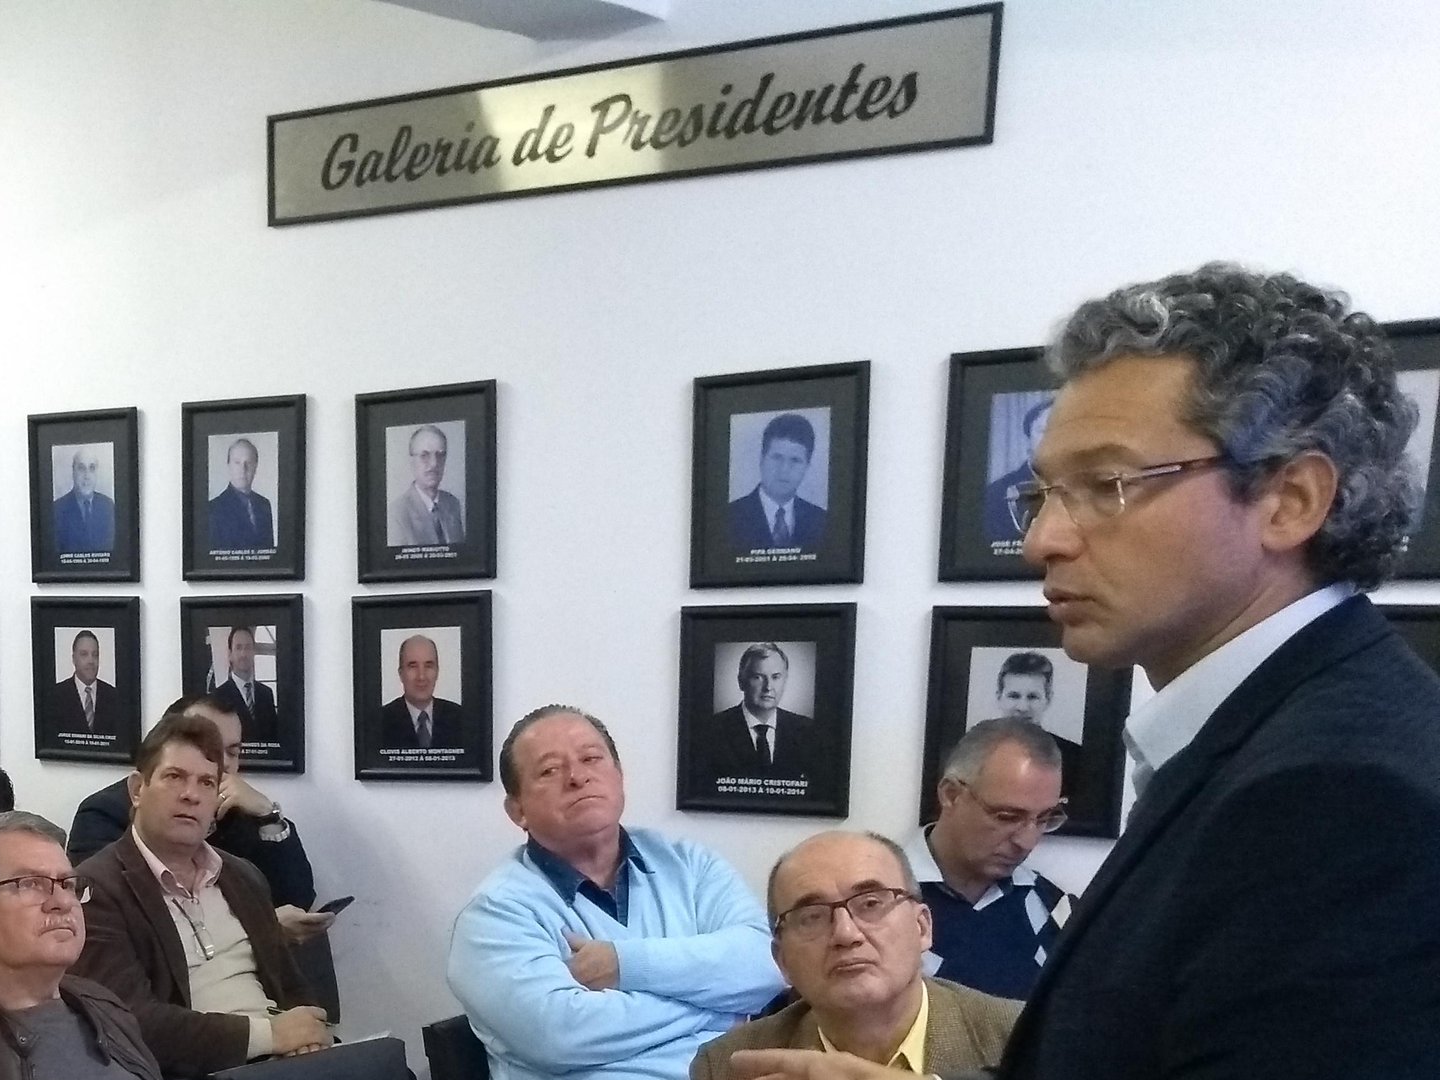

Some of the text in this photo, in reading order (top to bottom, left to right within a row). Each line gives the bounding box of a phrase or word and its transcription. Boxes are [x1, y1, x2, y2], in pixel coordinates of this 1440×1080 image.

[321, 63, 920, 191] Galeria de Presidentes
[716, 776, 737, 784] JOÃO
[763, 779, 809, 788] CRISTOFARI
